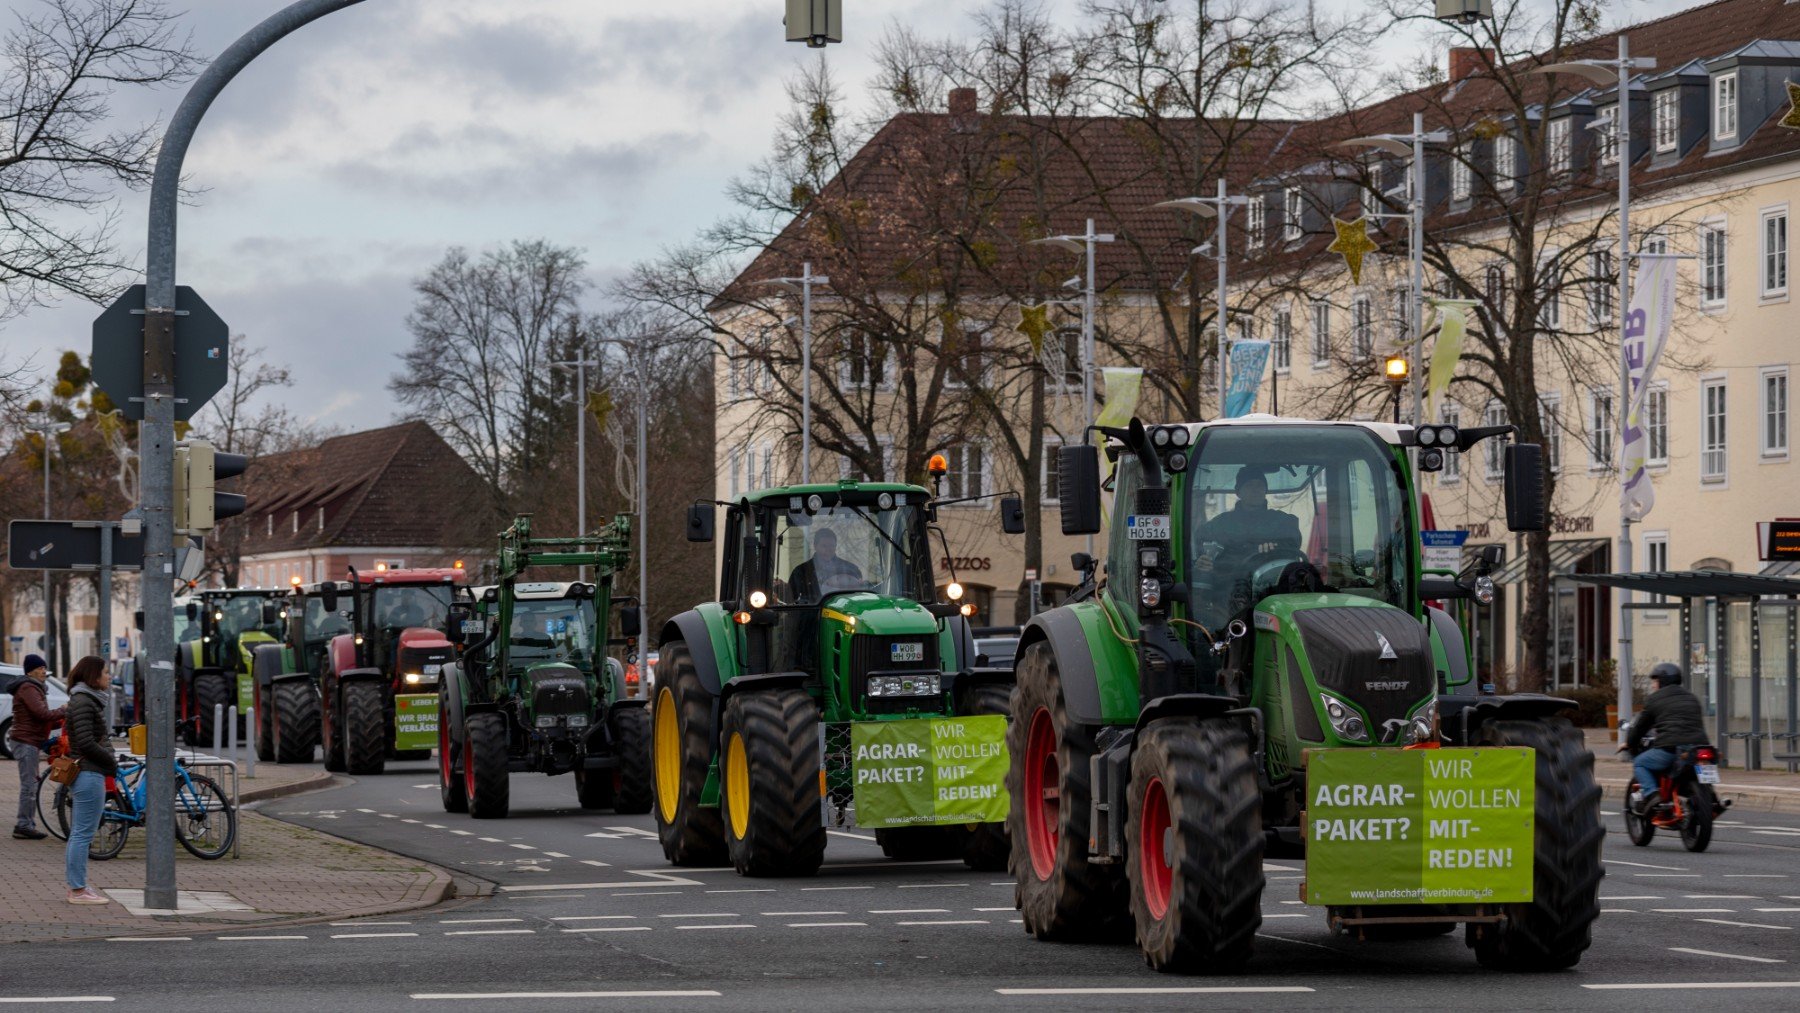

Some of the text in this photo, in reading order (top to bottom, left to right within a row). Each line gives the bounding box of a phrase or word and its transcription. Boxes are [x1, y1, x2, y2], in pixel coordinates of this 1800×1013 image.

[1138, 517, 1151, 528] GF
[1146, 528, 1166, 538] 516
[1365, 681, 1410, 691] FENDT
[934, 724, 965, 739] WIR
[857, 743, 926, 760] AGRAR-
[936, 743, 1000, 759] WOLLEN
[858, 765, 924, 784] PAKET?
[937, 765, 973, 780] MIT-
[1429, 760, 1473, 778] WIR
[938, 784, 997, 800] REDEN!
[1315, 784, 1415, 806] AGRAR-
[1429, 788, 1521, 809] WOLLEN
[1315, 817, 1411, 841] PAKET?
[1429, 819, 1480, 839] MIT-
[1429, 848, 1512, 868] REDEN!
